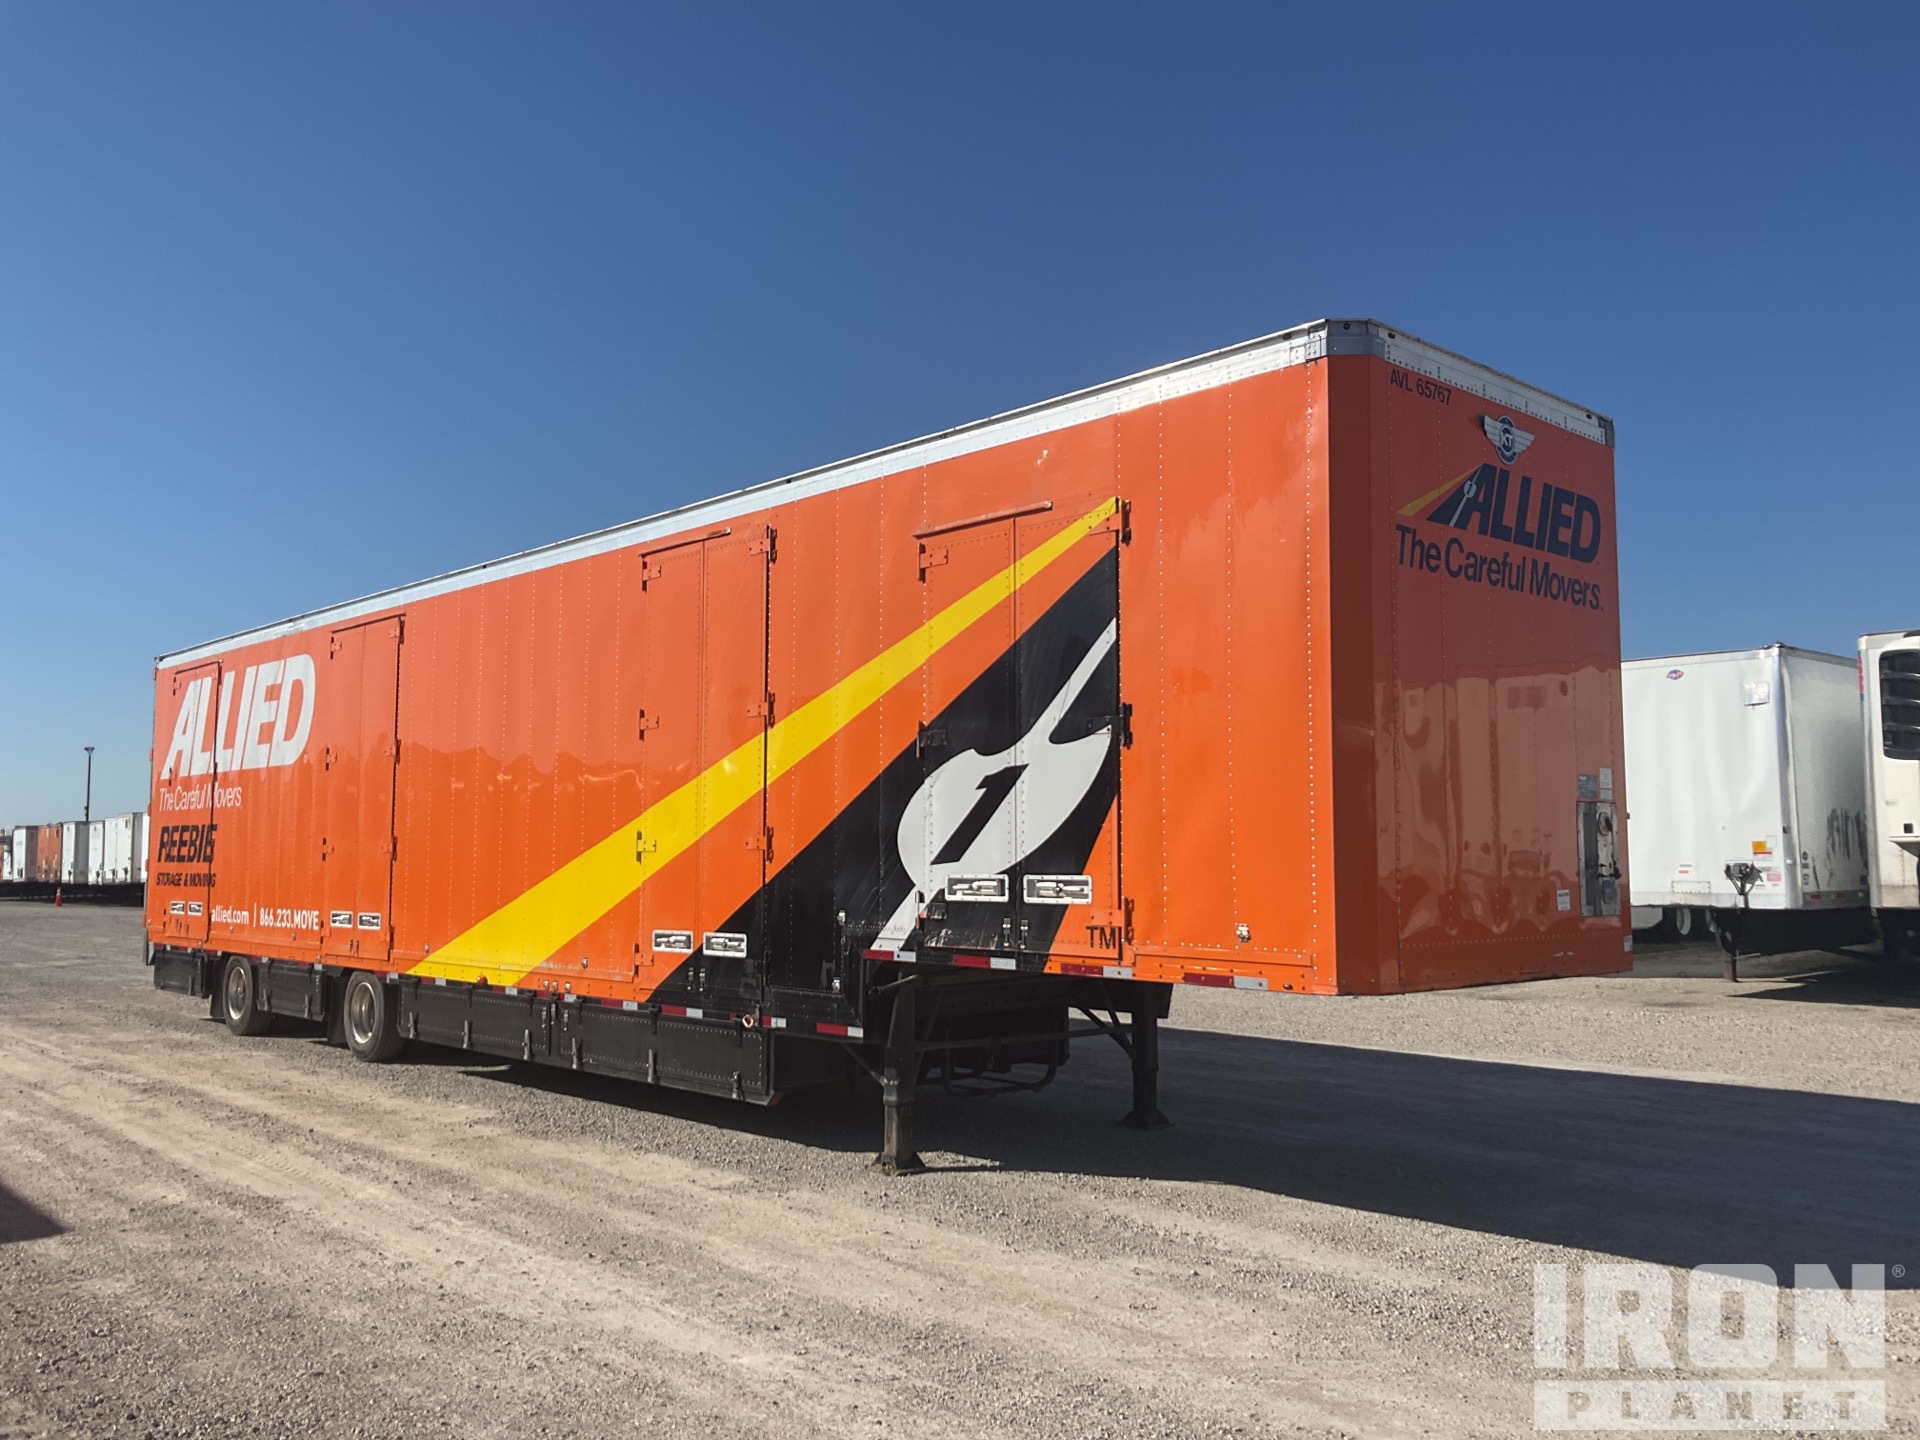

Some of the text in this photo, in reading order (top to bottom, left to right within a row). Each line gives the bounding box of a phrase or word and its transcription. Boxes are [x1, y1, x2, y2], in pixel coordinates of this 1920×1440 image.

[1390, 368, 1452, 405] AVL 65767
[1427, 463, 1601, 564] ALLIED
[1395, 524, 1441, 573] The
[1445, 537, 1526, 592] Careful
[160, 654, 316, 780] ALLIED
[159, 787, 174, 812] The
[174, 784, 206, 811] Careful
[157, 824, 217, 863] REEBIE
[156, 872, 183, 887] STORAGE
[211, 905, 320, 931] allied.com 866.233.MOVE
[1086, 925, 1119, 950] TM
